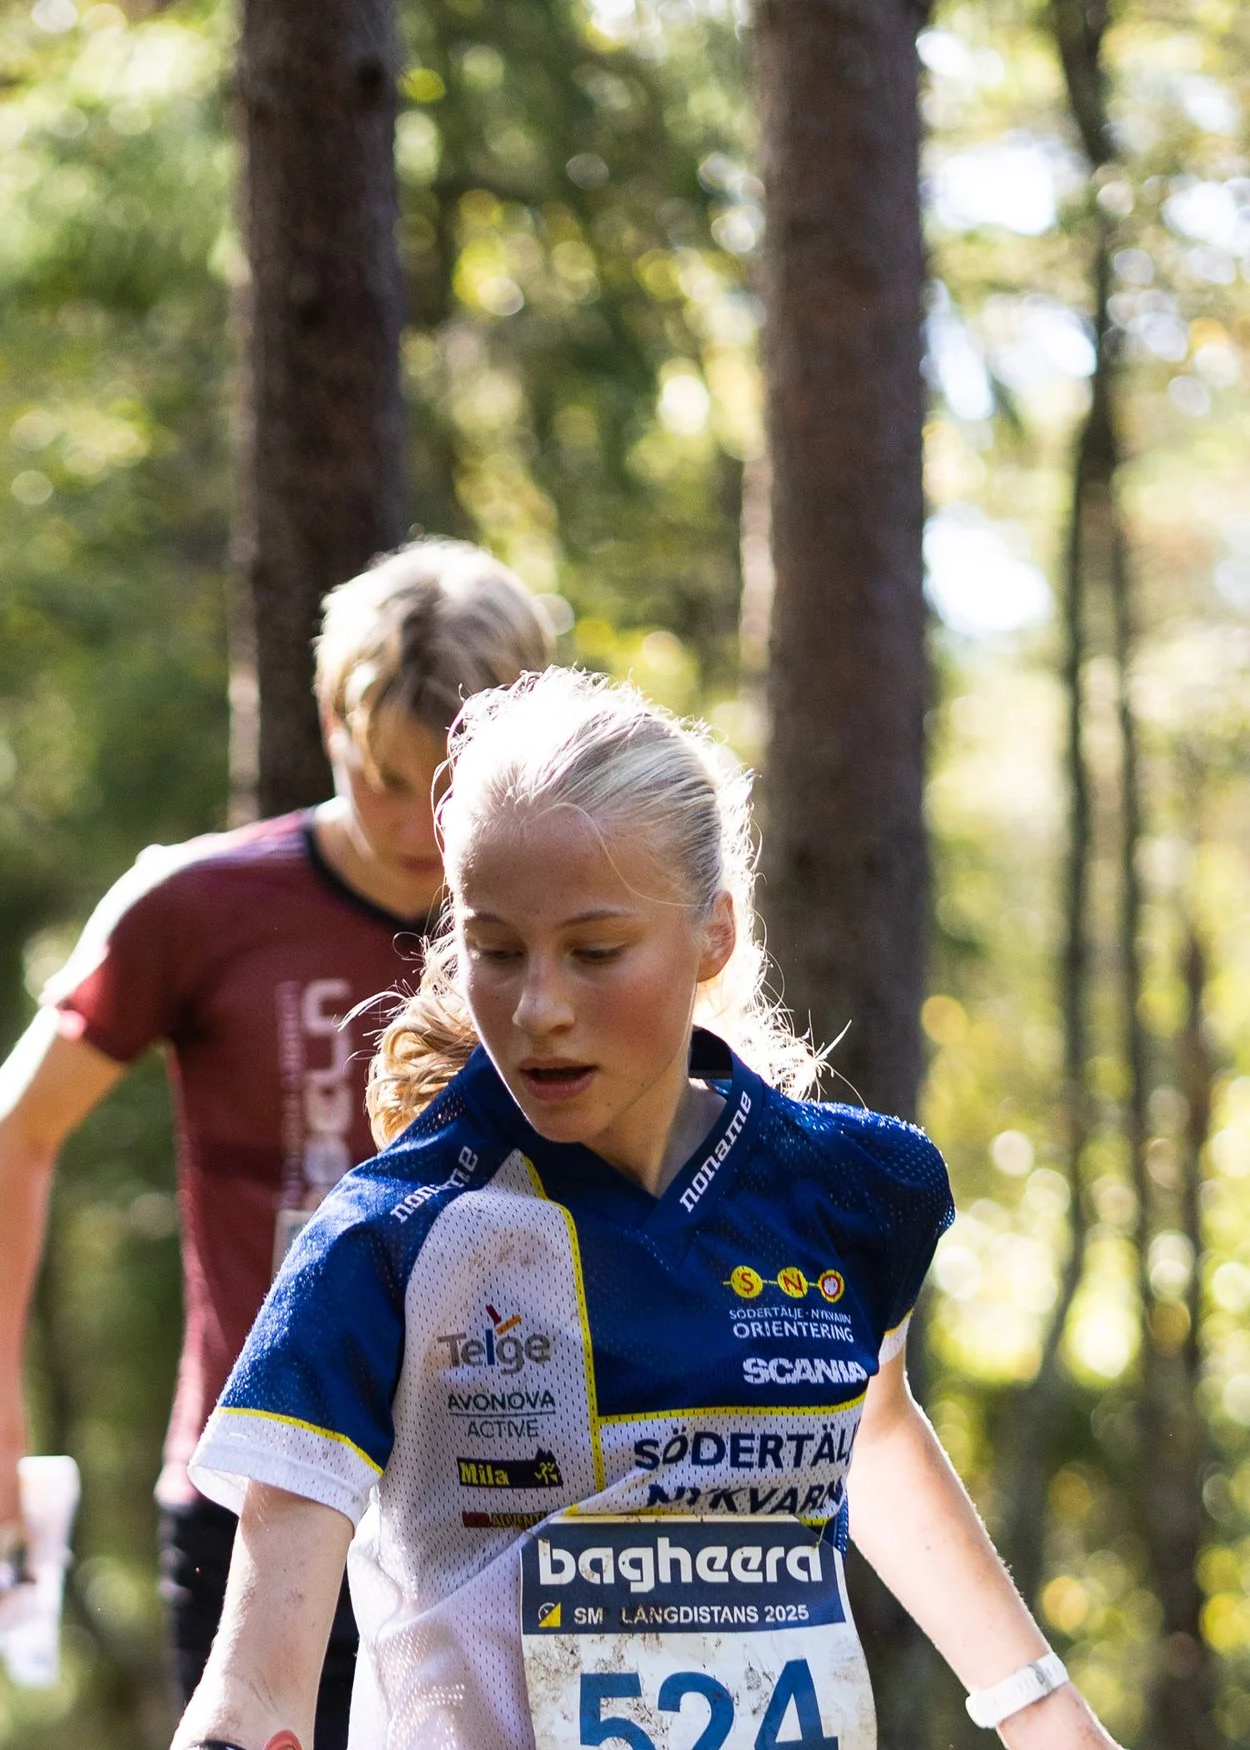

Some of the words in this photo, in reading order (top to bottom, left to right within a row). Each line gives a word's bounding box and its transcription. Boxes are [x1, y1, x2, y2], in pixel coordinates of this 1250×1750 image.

[680, 1090, 751, 1213] noname
[733, 1320, 855, 1343] ORIENTERING
[436, 1328, 551, 1375] Telge
[742, 1357, 868, 1385] SCANIA
[447, 1390, 556, 1411] AVONOVA
[467, 1419, 540, 1438] ACTIVE
[459, 1462, 510, 1486] Mila
[538, 1537, 823, 1593] bagheera
[573, 1607, 603, 1624] SM
[765, 1604, 810, 1623] 2025
